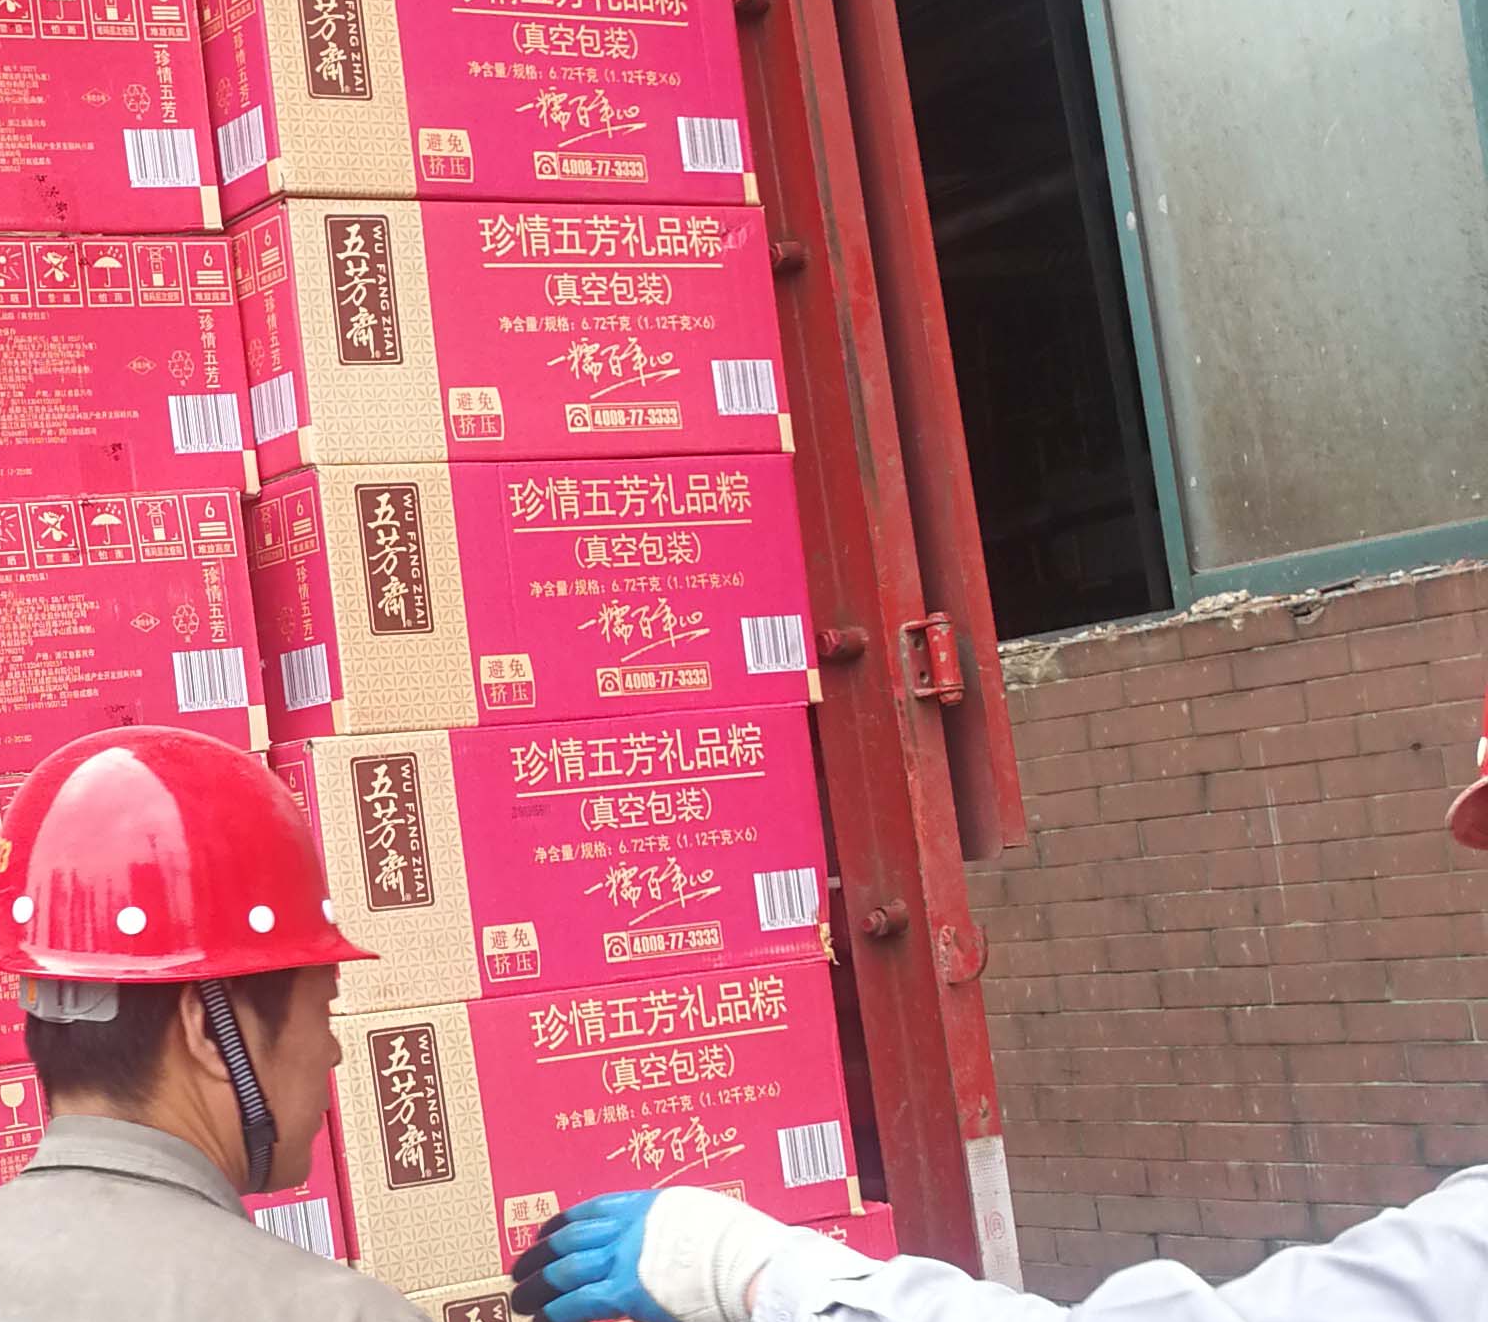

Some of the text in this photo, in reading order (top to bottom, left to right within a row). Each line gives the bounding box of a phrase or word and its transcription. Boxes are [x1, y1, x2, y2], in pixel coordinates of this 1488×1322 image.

[345, 1, 359, 46] FANG
[513, 22, 638, 60] （真空包装）
[153, 49, 177, 120] 珍情五芳
[351, 53, 364, 91] ZHAI
[426, 133, 464, 152] 避免
[429, 158, 465, 175] 挤压
[562, 157, 644, 178] 4008-77-3333
[264, 229, 272, 246] 6
[479, 216, 722, 258] 珍情五芳礼品粽
[203, 250, 213, 267] 6
[371, 226, 394, 355] WU FANG ZHAI
[546, 274, 673, 306] （真空包装）
[199, 313, 220, 384] 珍情五芳
[457, 392, 495, 411] 避免
[595, 408, 678, 426] 4008-77-3333
[460, 417, 496, 434] 挤压
[205, 501, 216, 519] 6
[296, 501, 303, 516] 6
[508, 471, 750, 522] 珍情五芳礼品粽
[402, 493, 425, 624] WU FANG ZHAI
[575, 532, 701, 568] （真空包装）
[203, 567, 227, 638] 珍情五芳
[296, 566, 313, 636] 珍情五芳
[487, 658, 526, 679] 避免
[625, 668, 707, 689] 4008-77-3333
[491, 683, 527, 702] 挤压
[511, 721, 763, 786] 珍情五芳礼品粽
[581, 788, 712, 831] （真空包装）
[400, 763, 426, 898] WU FANG ZHAI
[491, 928, 531, 951] 避免
[633, 928, 719, 954] 4008-77-3333
[495, 954, 532, 975] 挤压
[530, 973, 785, 1052] 珍情五芳礼品粽
[601, 1044, 734, 1095] （真空包装）
[418, 1033, 445, 1173] WU FANG ZHAI
[510, 1198, 551, 1224] 避免
